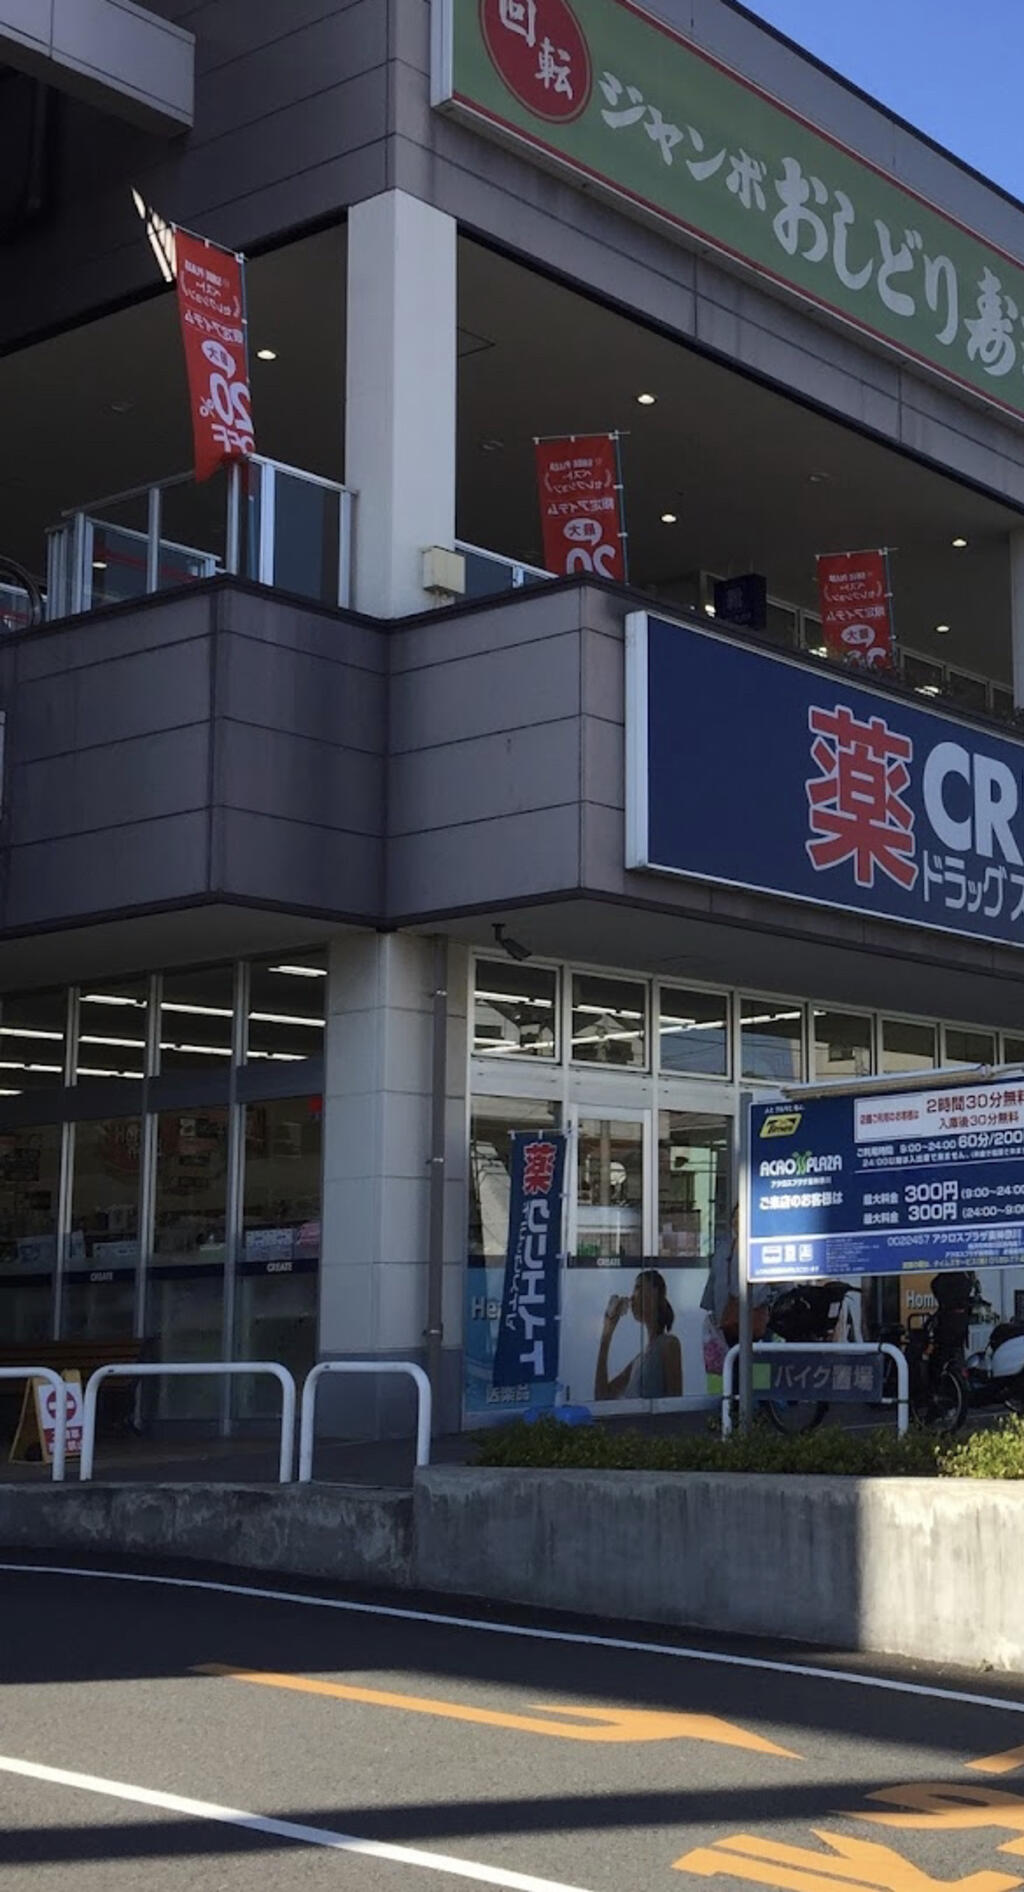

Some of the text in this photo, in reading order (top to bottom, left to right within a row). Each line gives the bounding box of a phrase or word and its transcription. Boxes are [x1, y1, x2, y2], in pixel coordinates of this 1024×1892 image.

[499, 0, 574, 100] 回転
[805, 704, 919, 891] 薬
[904, 1180, 959, 1203] 300円
[908, 1202, 958, 1221] 300円
[774, 1364, 874, 1392] バイク置場
